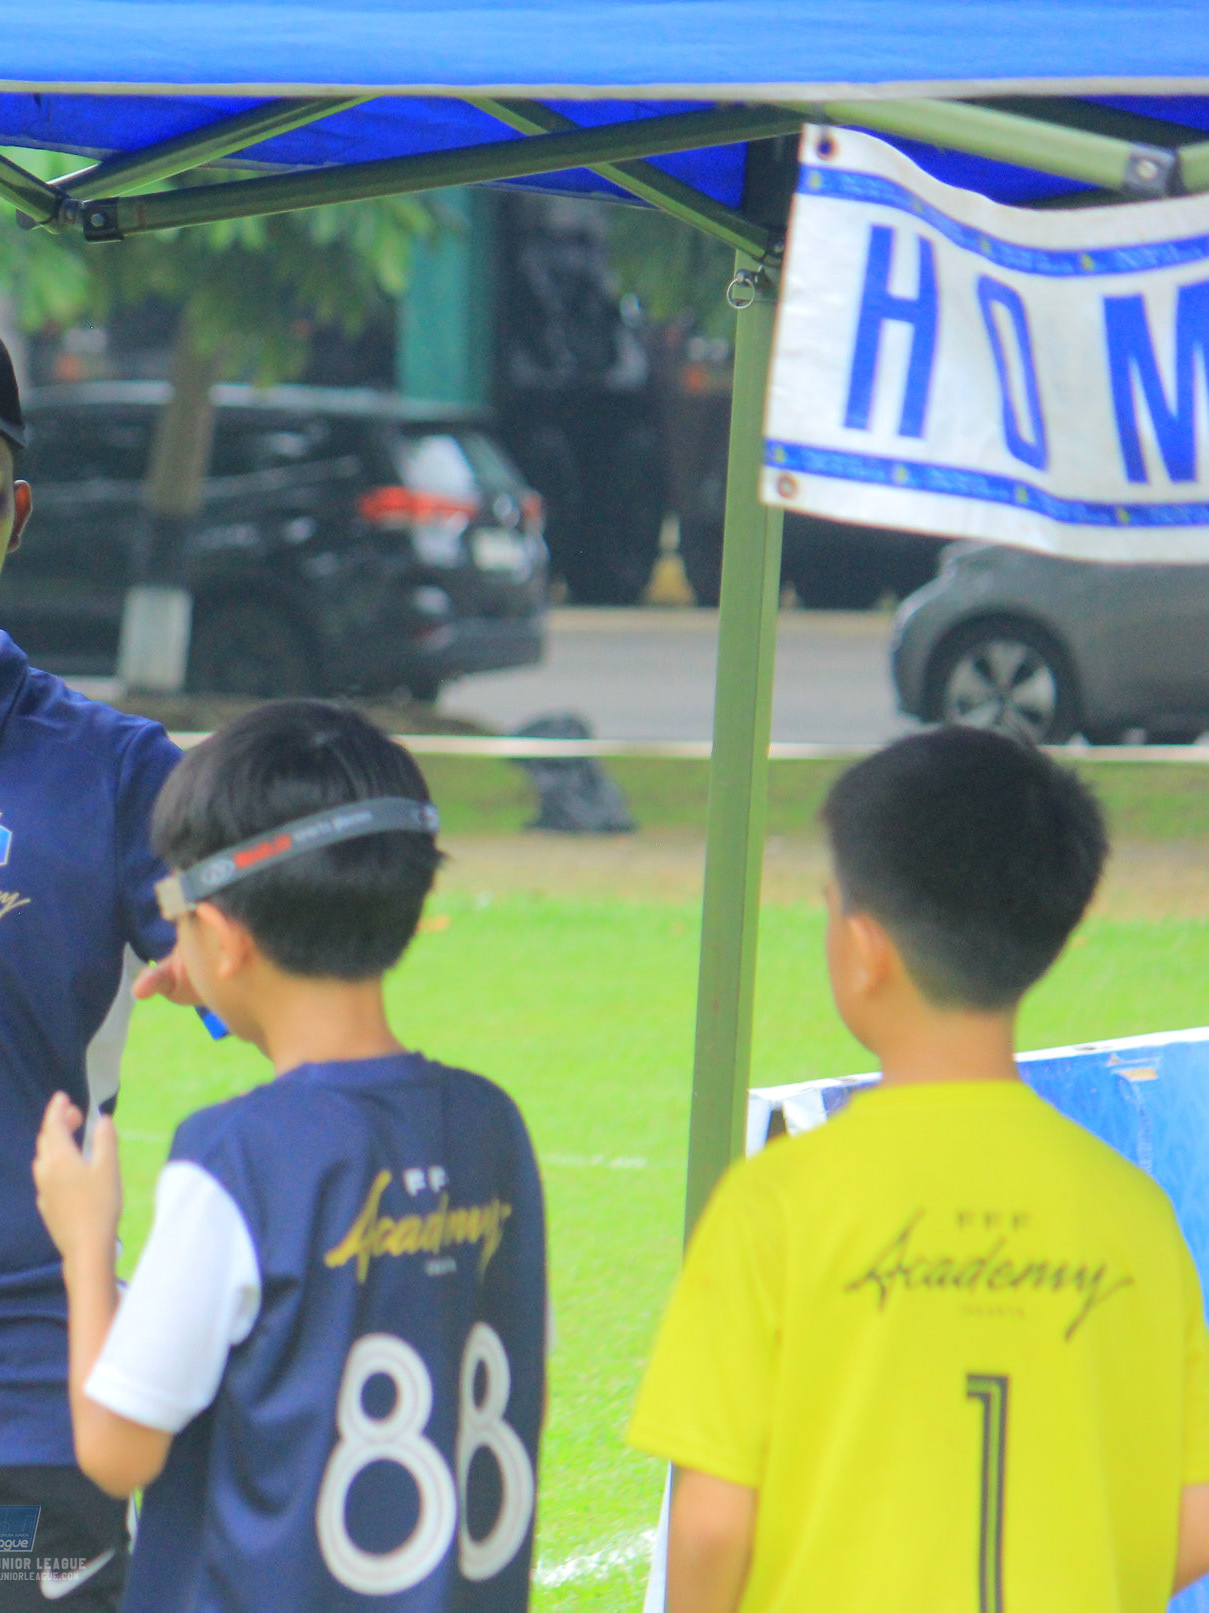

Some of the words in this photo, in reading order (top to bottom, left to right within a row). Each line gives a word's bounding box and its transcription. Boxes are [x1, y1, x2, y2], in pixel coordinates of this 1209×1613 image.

[323, 1168, 512, 1284] Academy
[842, 1206, 1136, 1343] Academy
[955, 1209, 1033, 1232] FFF
[316, 1321, 534, 1595] 88
[965, 1373, 1010, 1613] 1
